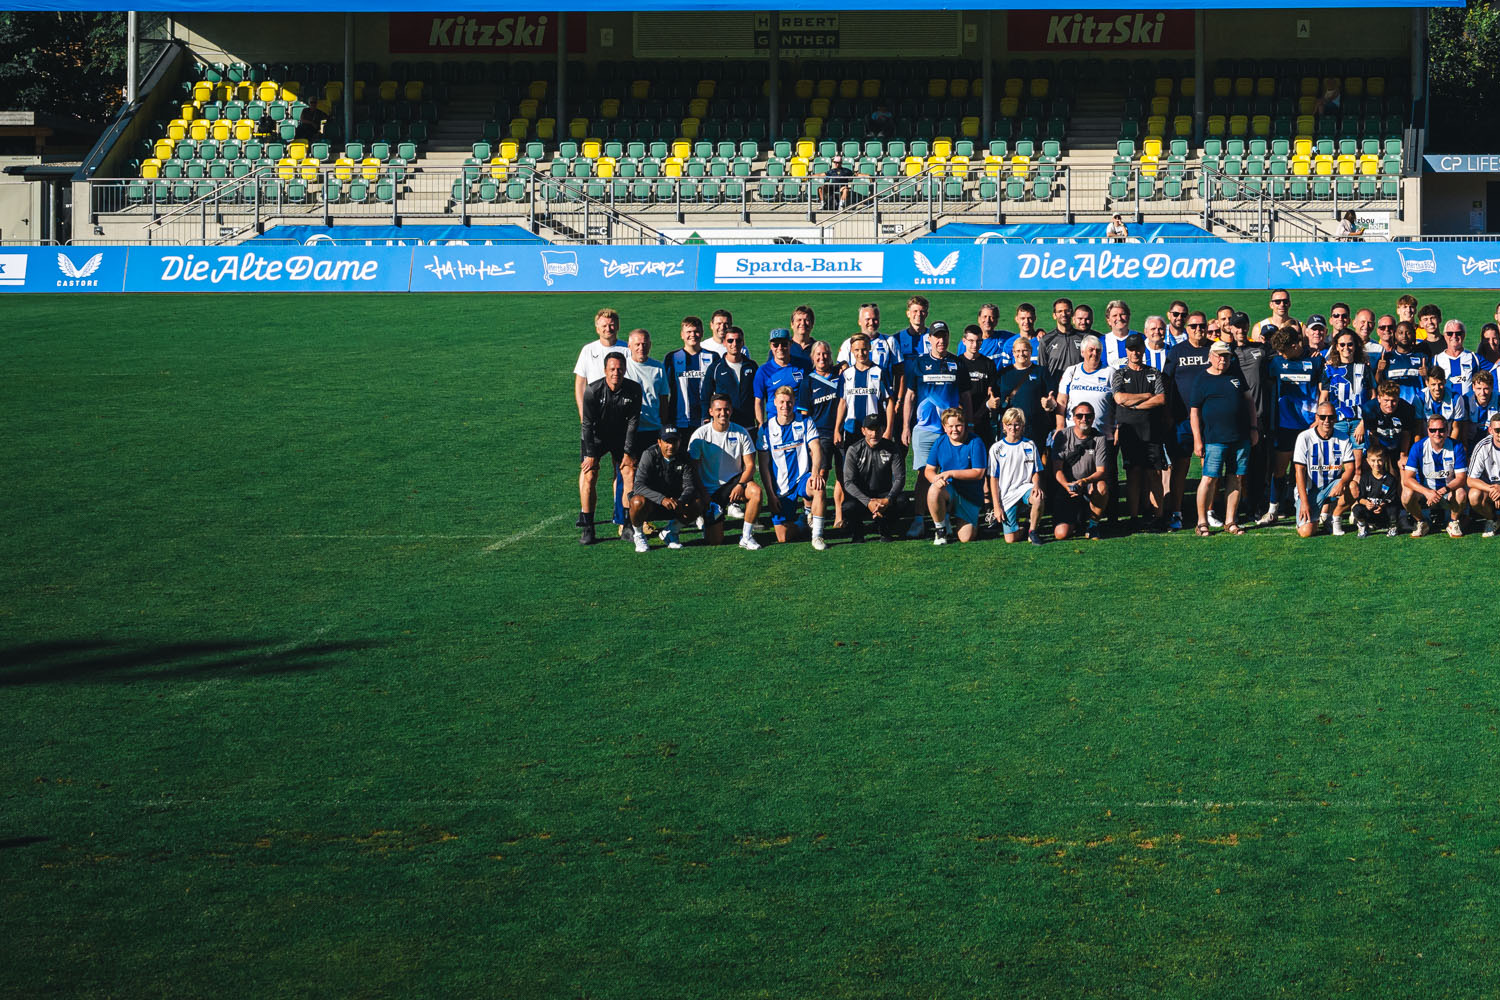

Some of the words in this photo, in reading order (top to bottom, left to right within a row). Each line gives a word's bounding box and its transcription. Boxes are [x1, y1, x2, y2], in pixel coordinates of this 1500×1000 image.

[758, 17, 837, 27] HRBERT
[1046, 13, 1166, 44] KitzSki
[429, 15, 548, 46] KitzSki
[757, 35, 837, 45] GNTHER
[1440, 156, 1462, 171] CP
[600, 226, 608, 235] C
[896, 224, 903, 234] B
[1262, 224, 1270, 233] A
[161, 254, 208, 281] Die
[211, 252, 283, 284] Alte
[286, 255, 378, 281] Dame
[736, 258, 862, 276] Sparda-Bank
[1017, 252, 1066, 279] Die
[1068, 250, 1140, 282] Alte
[1142, 253, 1236, 278] Dame
